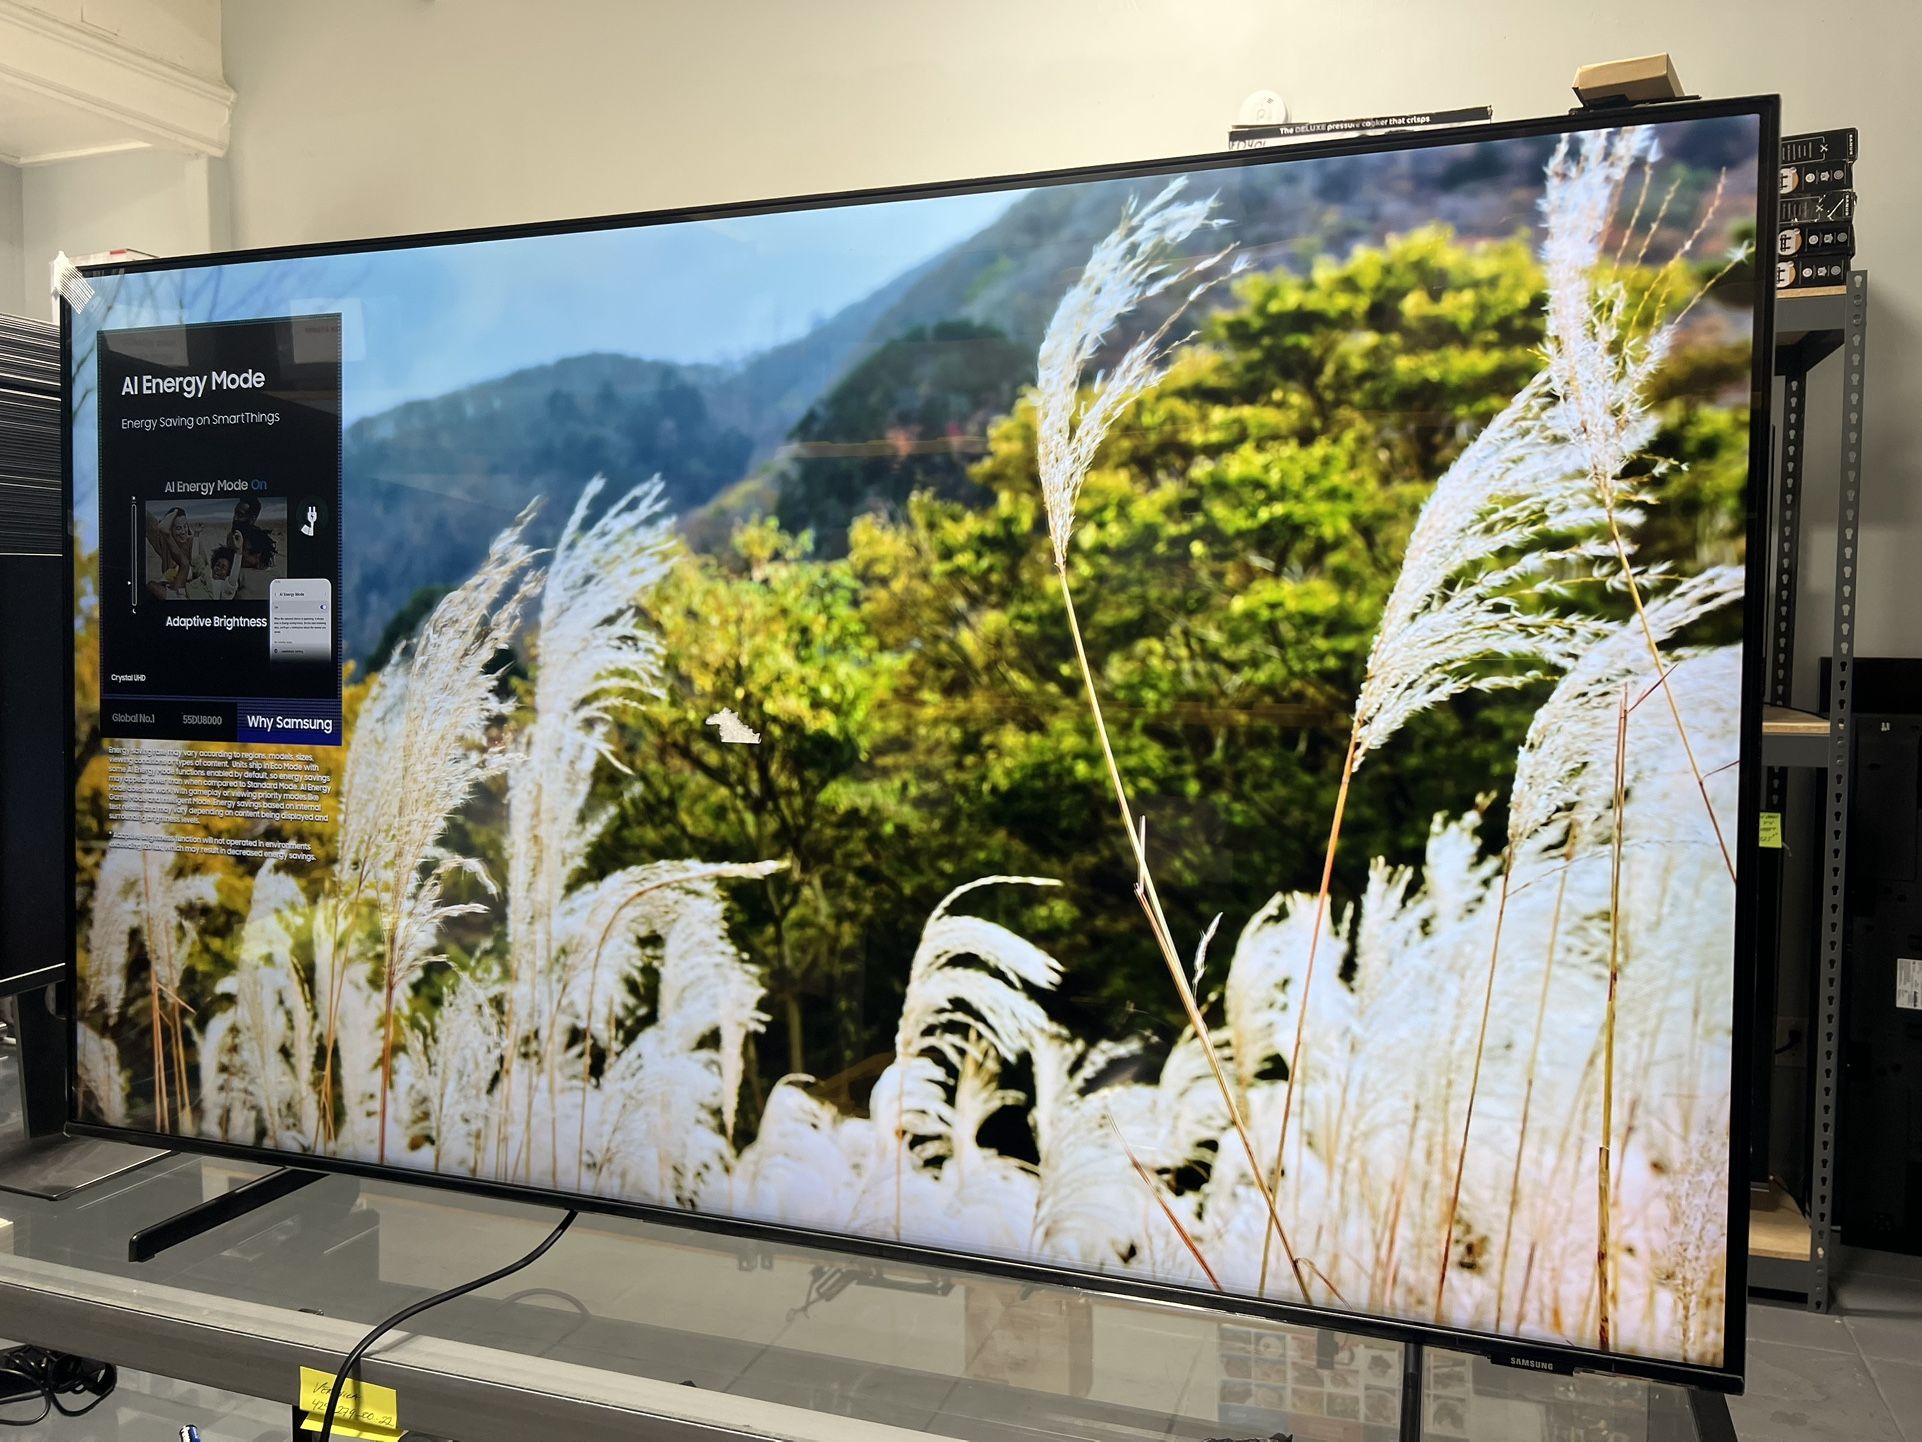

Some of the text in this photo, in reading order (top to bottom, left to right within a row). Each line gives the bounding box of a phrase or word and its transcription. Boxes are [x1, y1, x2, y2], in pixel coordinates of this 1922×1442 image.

[1280, 127, 1294, 135] The
[1295, 124, 1326, 133] DELUXE
[1327, 122, 1360, 132] pressure
[1388, 118, 1405, 126] that
[121, 369, 266, 398] AI Energy Mode
[121, 412, 280, 431] Energy Saving on SmartThings
[165, 479, 267, 495] AI Energy Mode On
[166, 616, 212, 630] Adaptive
[213, 615, 267, 630] Brightness
[111, 673, 133, 683] Crystal
[112, 712, 155, 723] Global No.1
[182, 714, 222, 725] 55DU8000
[247, 714, 333, 734] Why Samsung
[200, 751, 232, 760] according
[176, 758, 194, 767] types
[249, 762, 263, 770] ship
[234, 770, 242, 779] by
[304, 774, 330, 783] savings
[189, 789, 221, 798] gameplay
[231, 790, 256, 799] viewing
[259, 791, 283, 800] priority
[308, 784, 331, 793] Energy
[214, 798, 235, 808] Energy
[237, 800, 261, 809] savings
[189, 807, 224, 817] depending
[261, 811, 280, 821] being
[281, 812, 314, 822] displayed
[265, 841, 312, 849] environments
[227, 848, 263, 856] decreased
[264, 852, 288, 860] energy
[1510, 1357, 1553, 1370] SAMSUNG
